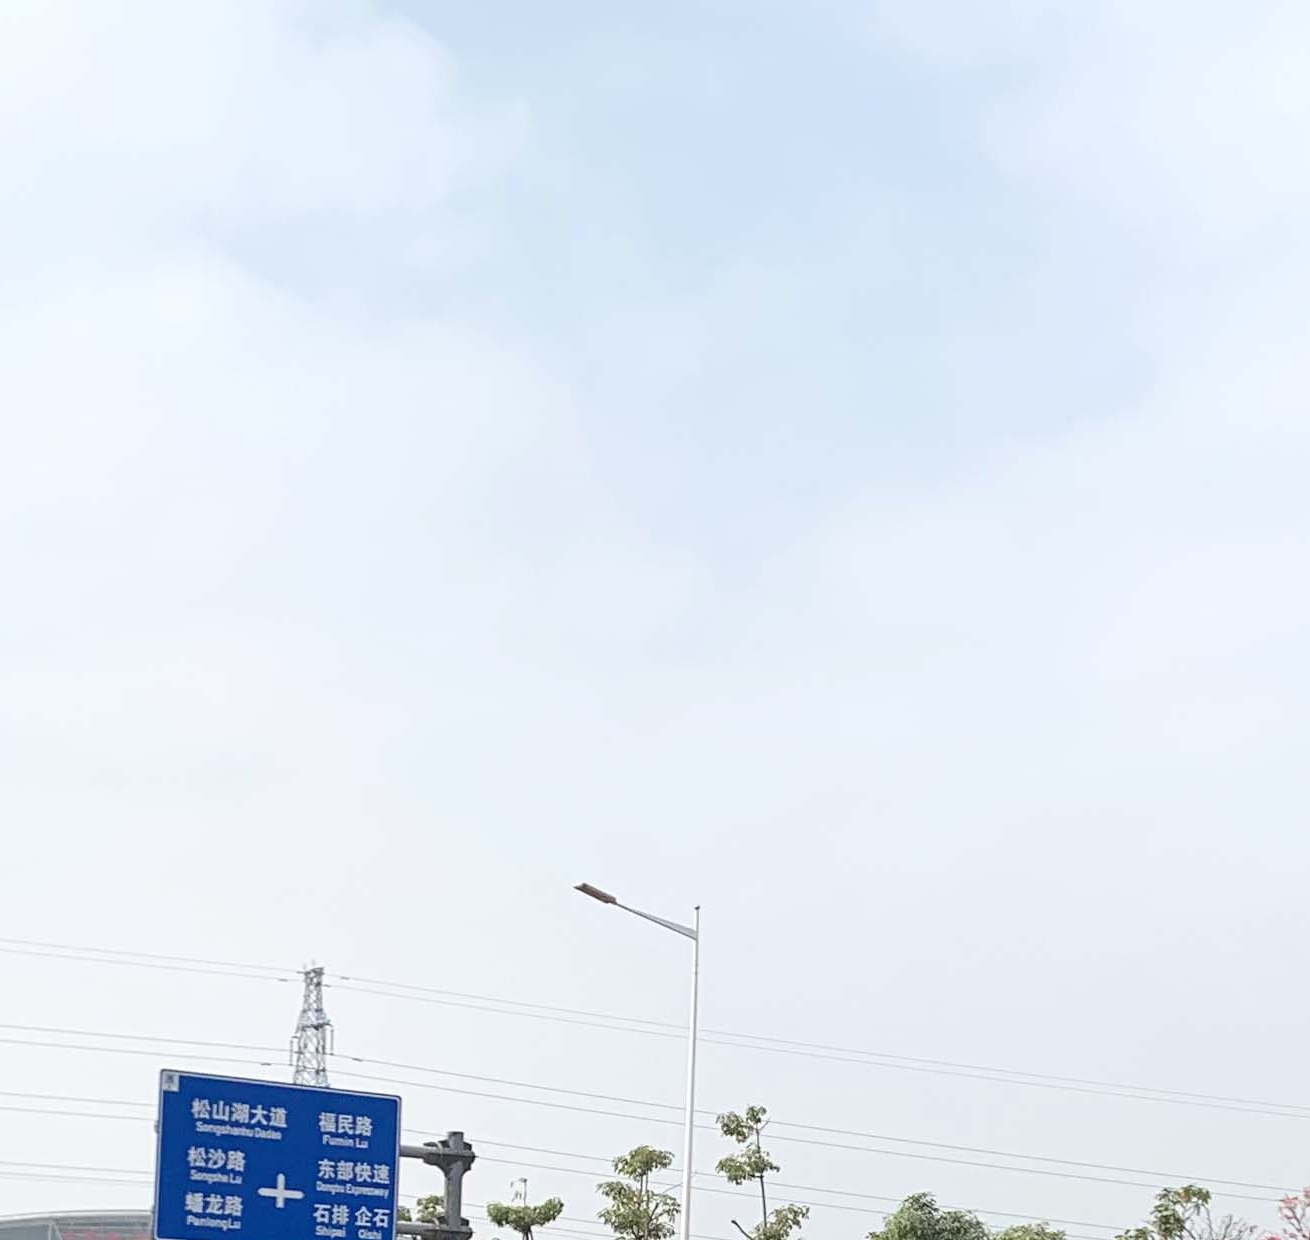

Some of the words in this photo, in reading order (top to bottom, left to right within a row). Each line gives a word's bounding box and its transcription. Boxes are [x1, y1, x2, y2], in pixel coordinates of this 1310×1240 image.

[191, 1097, 287, 1128] 松山湖大道
[319, 1112, 372, 1137] 福民路
[187, 1146, 246, 1172] 松沙路
[318, 1159, 390, 1185] 东部快速
[184, 1192, 243, 1217] 蟠龙路
[313, 1204, 350, 1226] 石排
[355, 1206, 391, 1229] 企石
